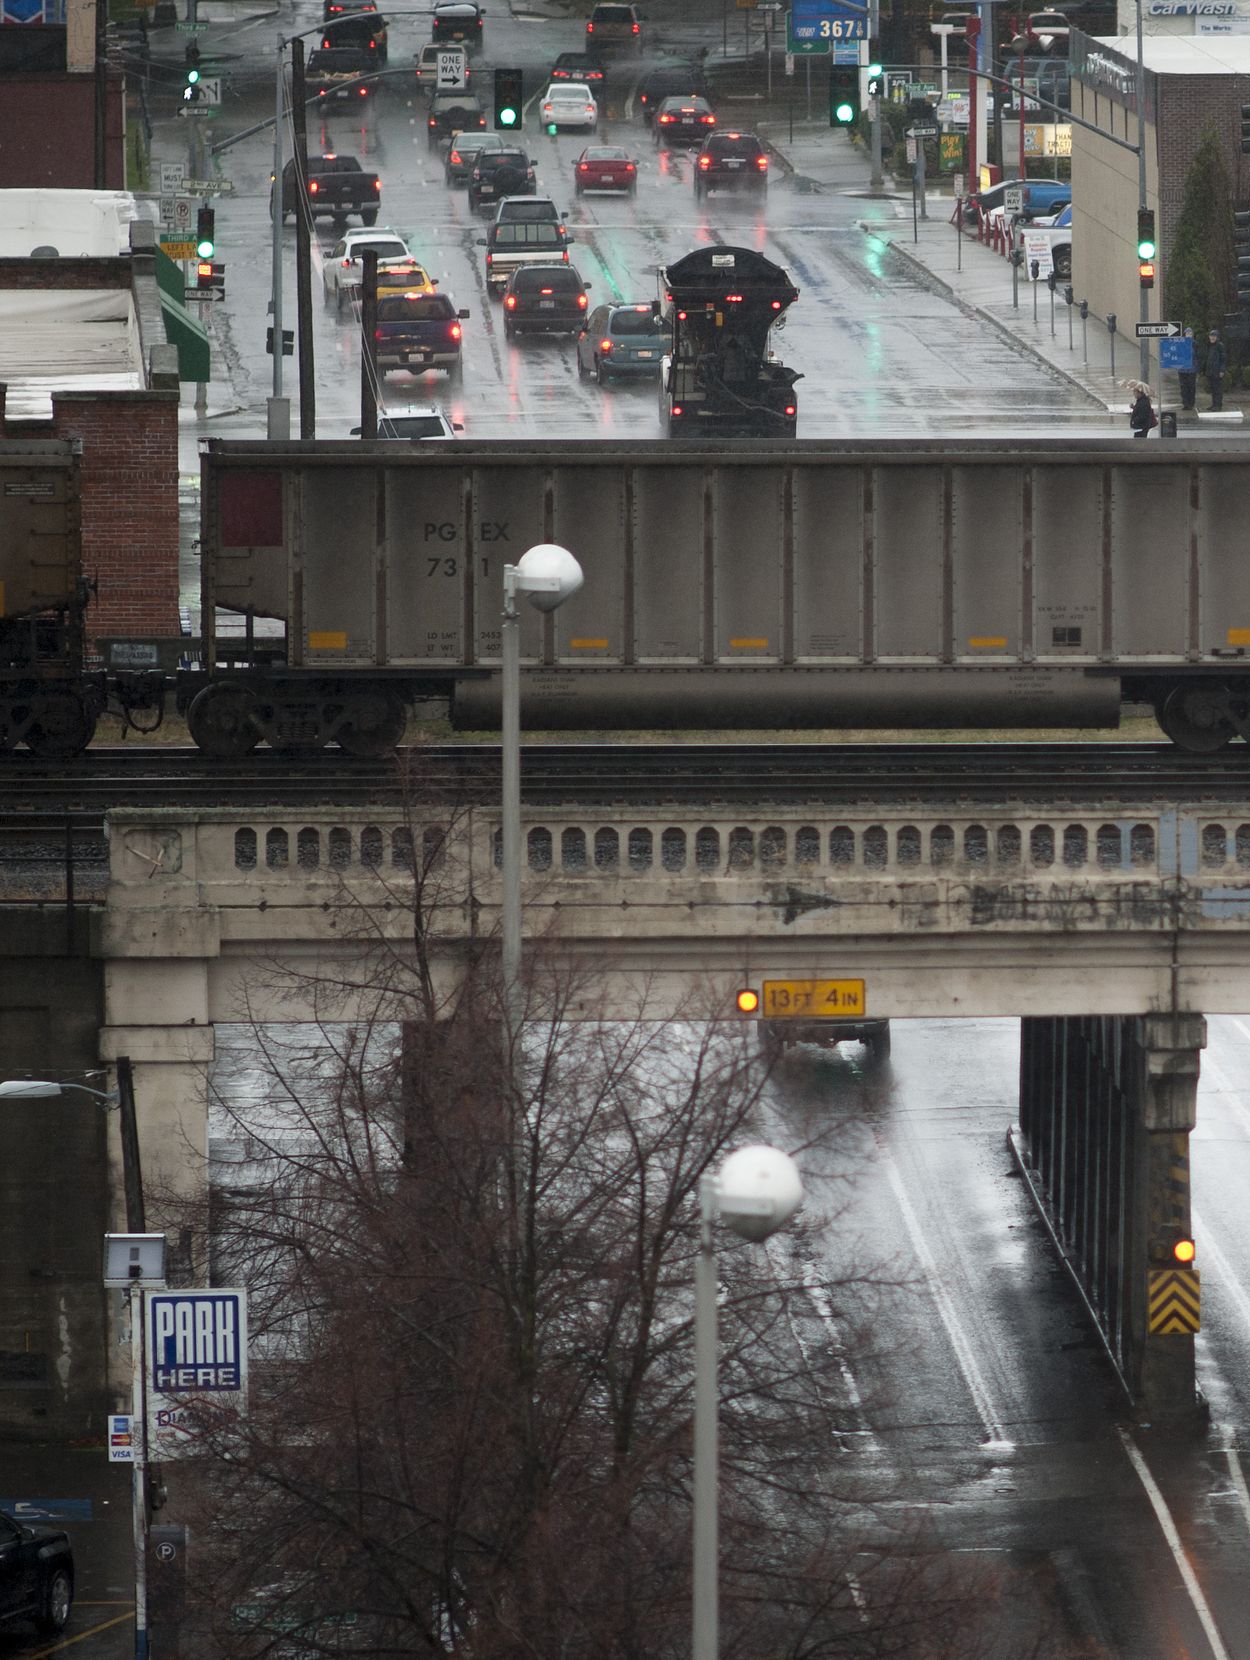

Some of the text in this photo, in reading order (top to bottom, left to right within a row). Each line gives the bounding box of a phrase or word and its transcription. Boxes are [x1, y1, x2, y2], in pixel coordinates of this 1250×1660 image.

[1150, 0, 1237, 15] Car Wash
[820, 20, 855, 37] 367
[441, 55, 461, 64] ONE
[440, 65, 461, 74] WAY
[941, 135, 960, 145] Play
[424, 522, 511, 542] PG EX
[427, 558, 457, 577] 73
[155, 1301, 235, 1364] PARK
[157, 1367, 236, 1388] HERE
[112, 1450, 132, 1459] VISA
